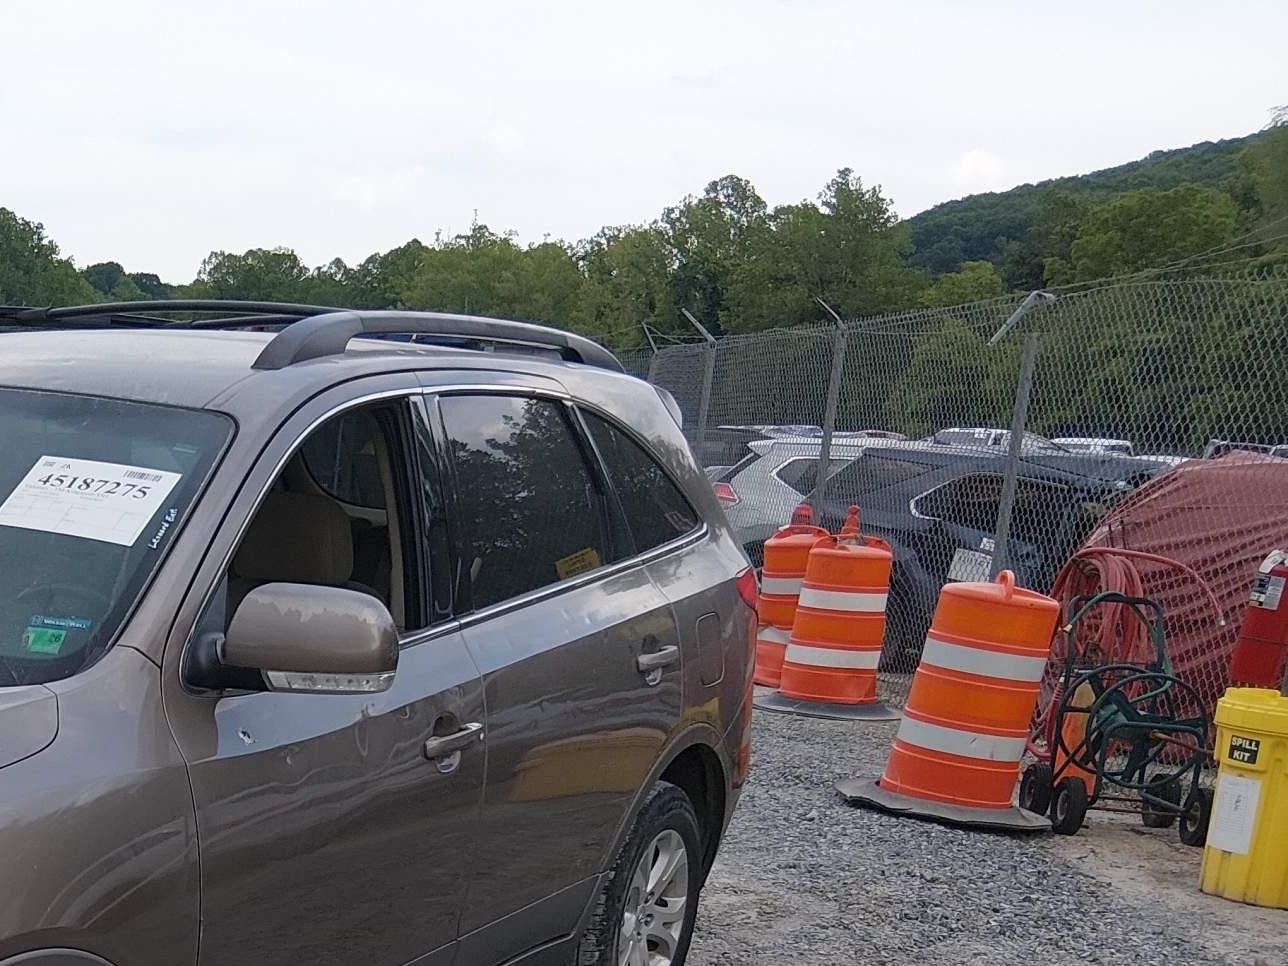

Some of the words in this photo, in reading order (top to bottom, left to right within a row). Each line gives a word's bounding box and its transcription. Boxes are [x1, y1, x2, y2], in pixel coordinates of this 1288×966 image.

[37, 473, 151, 499] 45187275
[1231, 736, 1258, 751] SPILL
[1232, 749, 1251, 762] KIT
